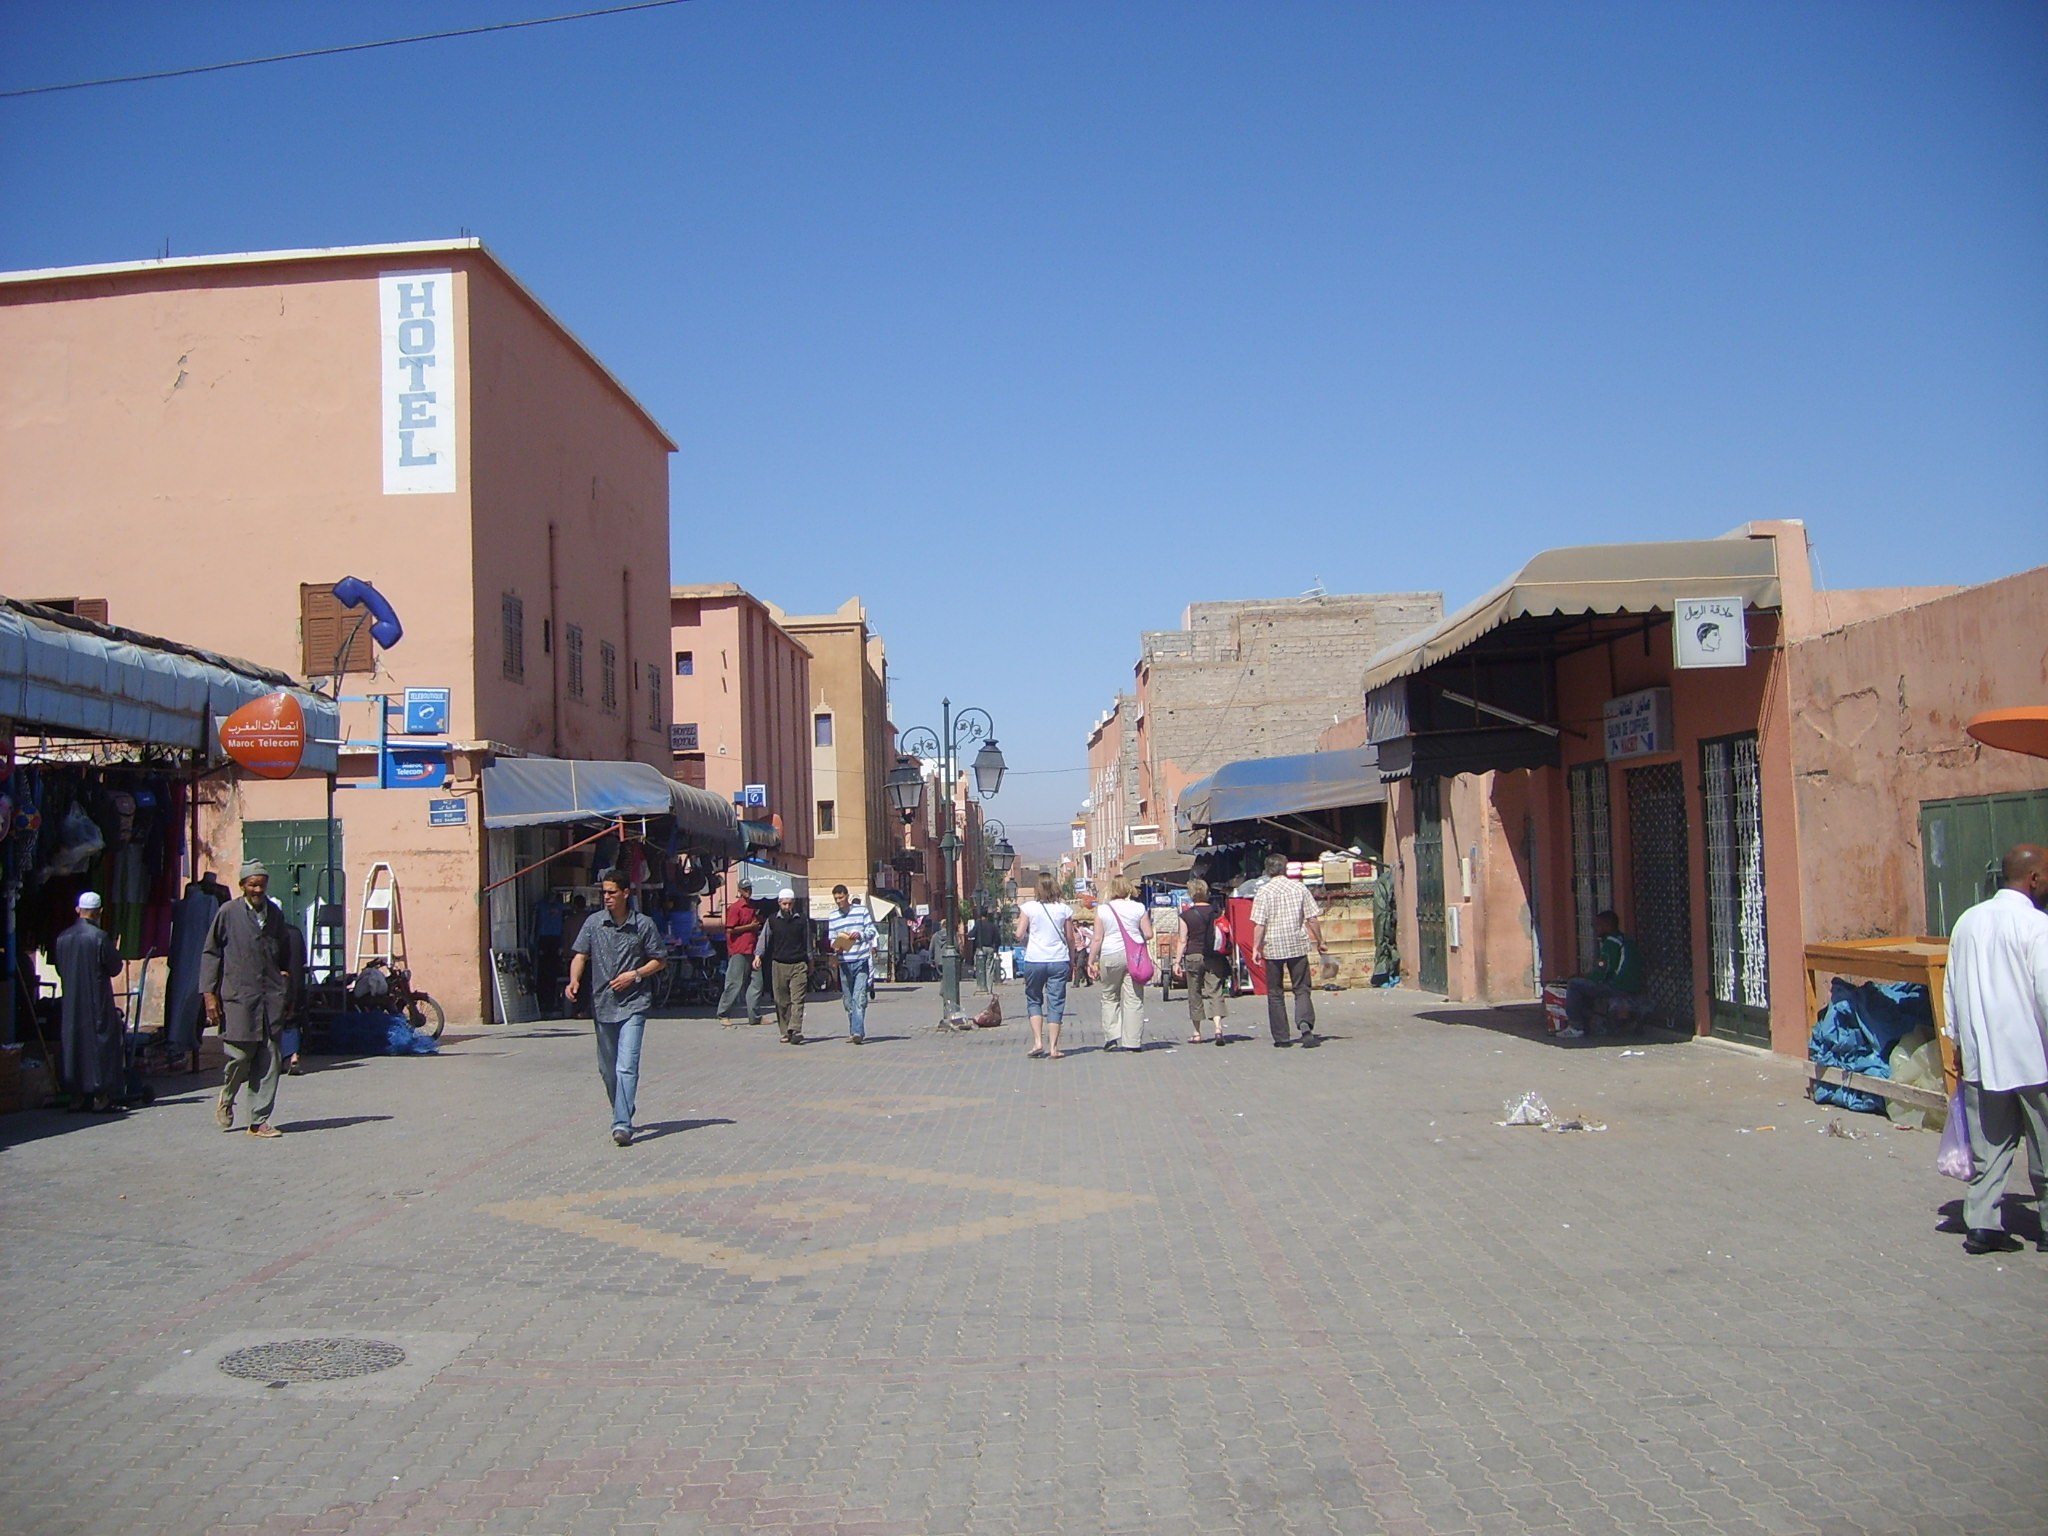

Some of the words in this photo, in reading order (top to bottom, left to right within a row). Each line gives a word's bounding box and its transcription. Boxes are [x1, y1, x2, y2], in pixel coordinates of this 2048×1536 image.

[397, 281, 437, 466] HOTEL
[228, 719, 260, 734] المغرب
[262, 720, 298, 730] اتصالات
[228, 739, 255, 748] Maroc
[258, 738, 299, 748] Telecom
[396, 768, 424, 776] Telecom
